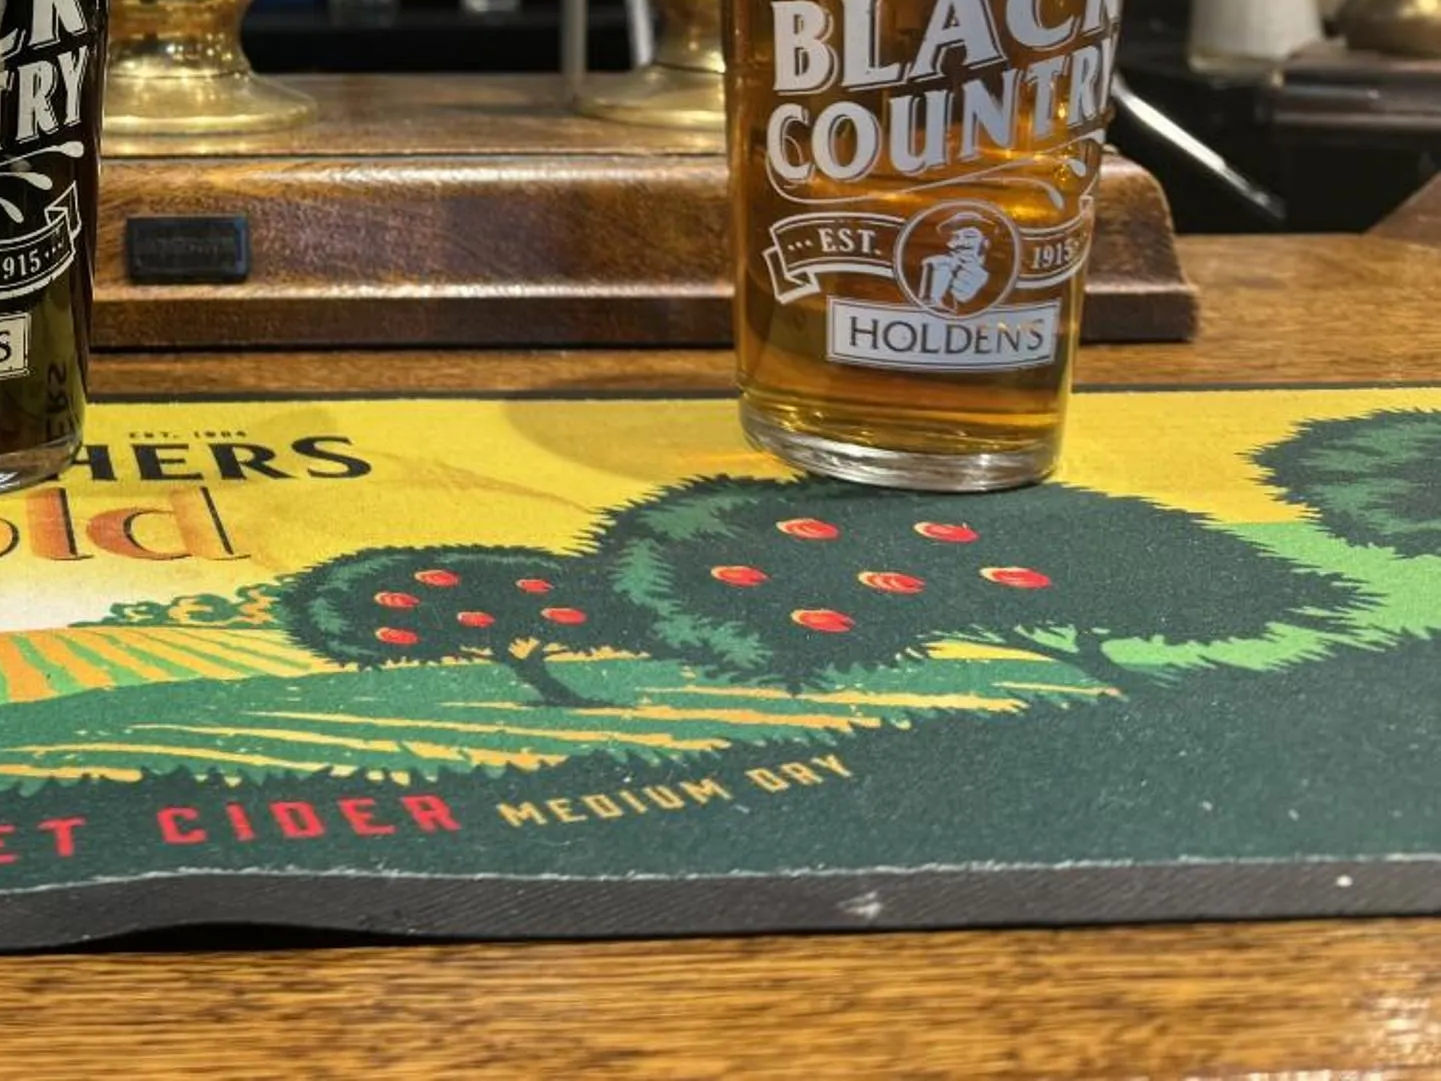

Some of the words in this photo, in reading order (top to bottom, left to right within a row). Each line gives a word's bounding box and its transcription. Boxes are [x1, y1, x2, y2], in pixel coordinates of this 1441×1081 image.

[849, 317, 1045, 354] HOLDENS
[158, 794, 461, 843] CIDER
[496, 777, 734, 829] MEDIUM
[754, 752, 857, 794] DRY
